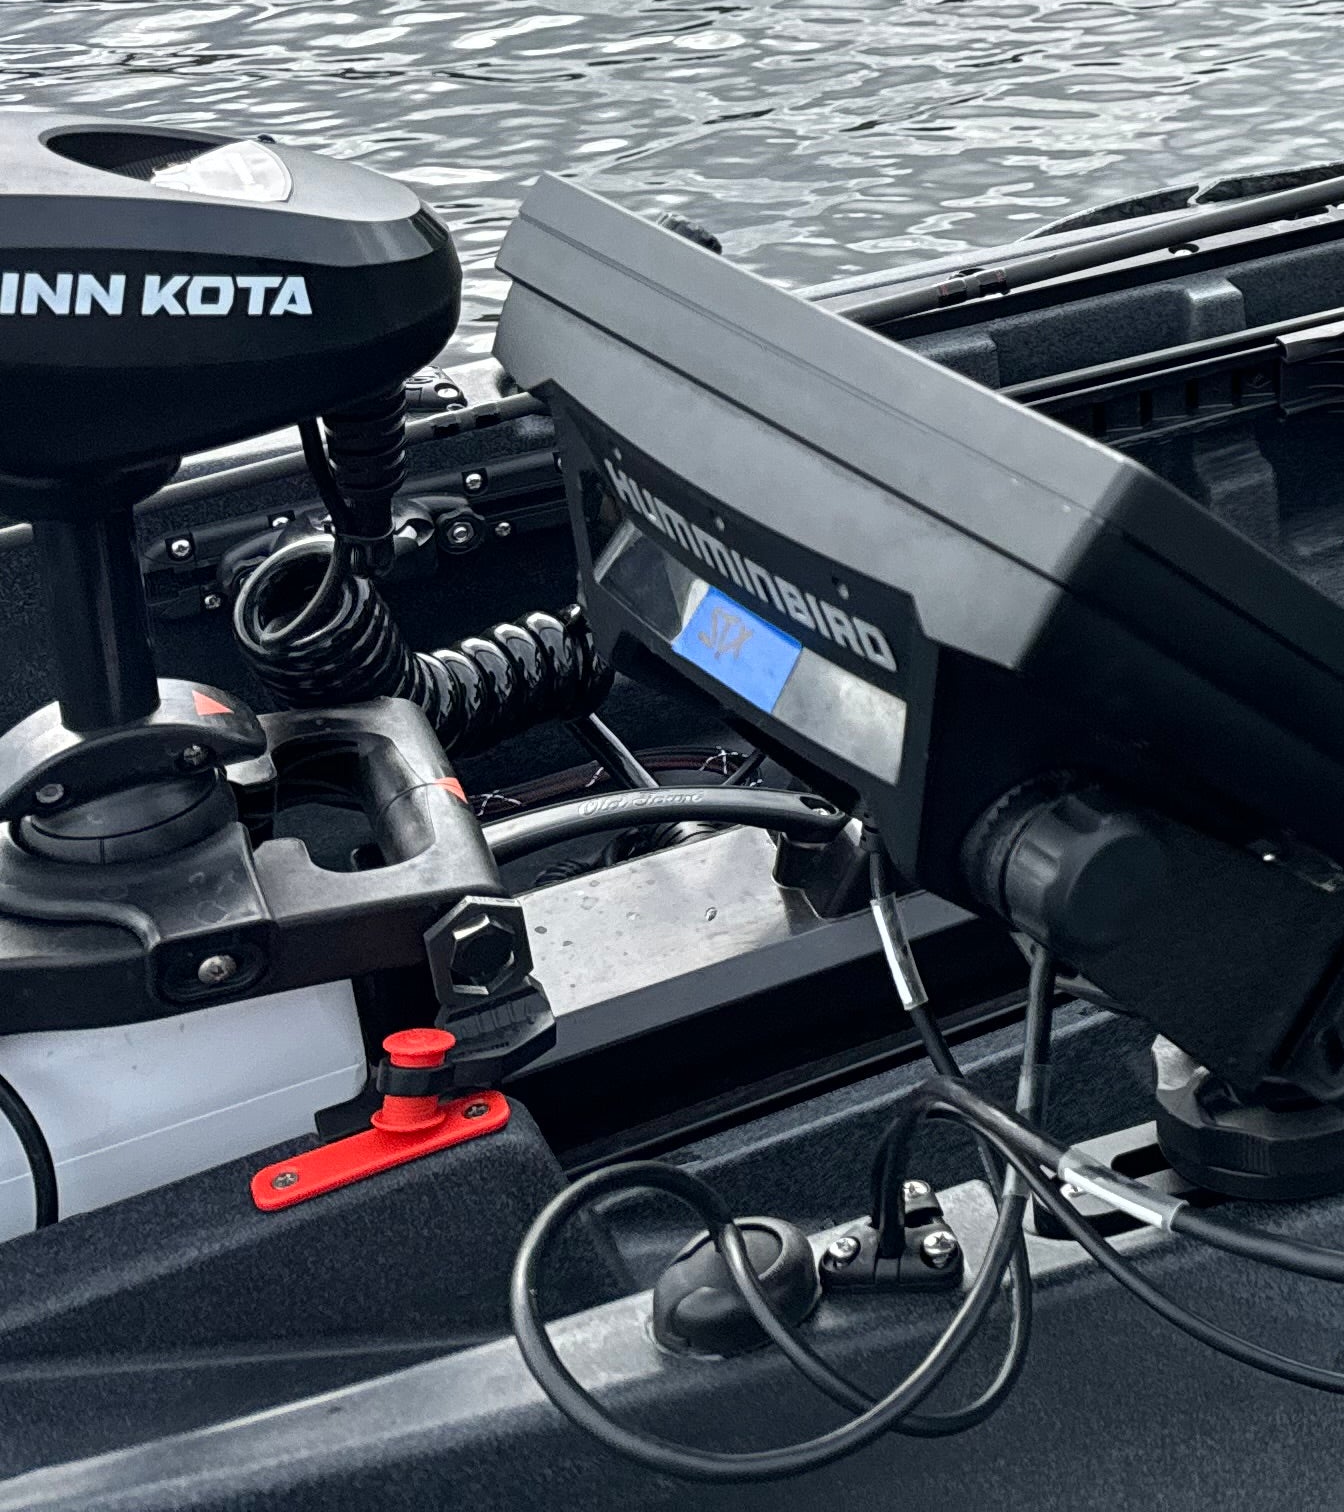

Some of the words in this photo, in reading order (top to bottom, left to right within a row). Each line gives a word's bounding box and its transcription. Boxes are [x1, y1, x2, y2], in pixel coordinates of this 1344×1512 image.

[0, 272, 126, 316] INN
[141, 275, 313, 316] KOTA
[603, 458, 897, 672] HUMMINBIRD
